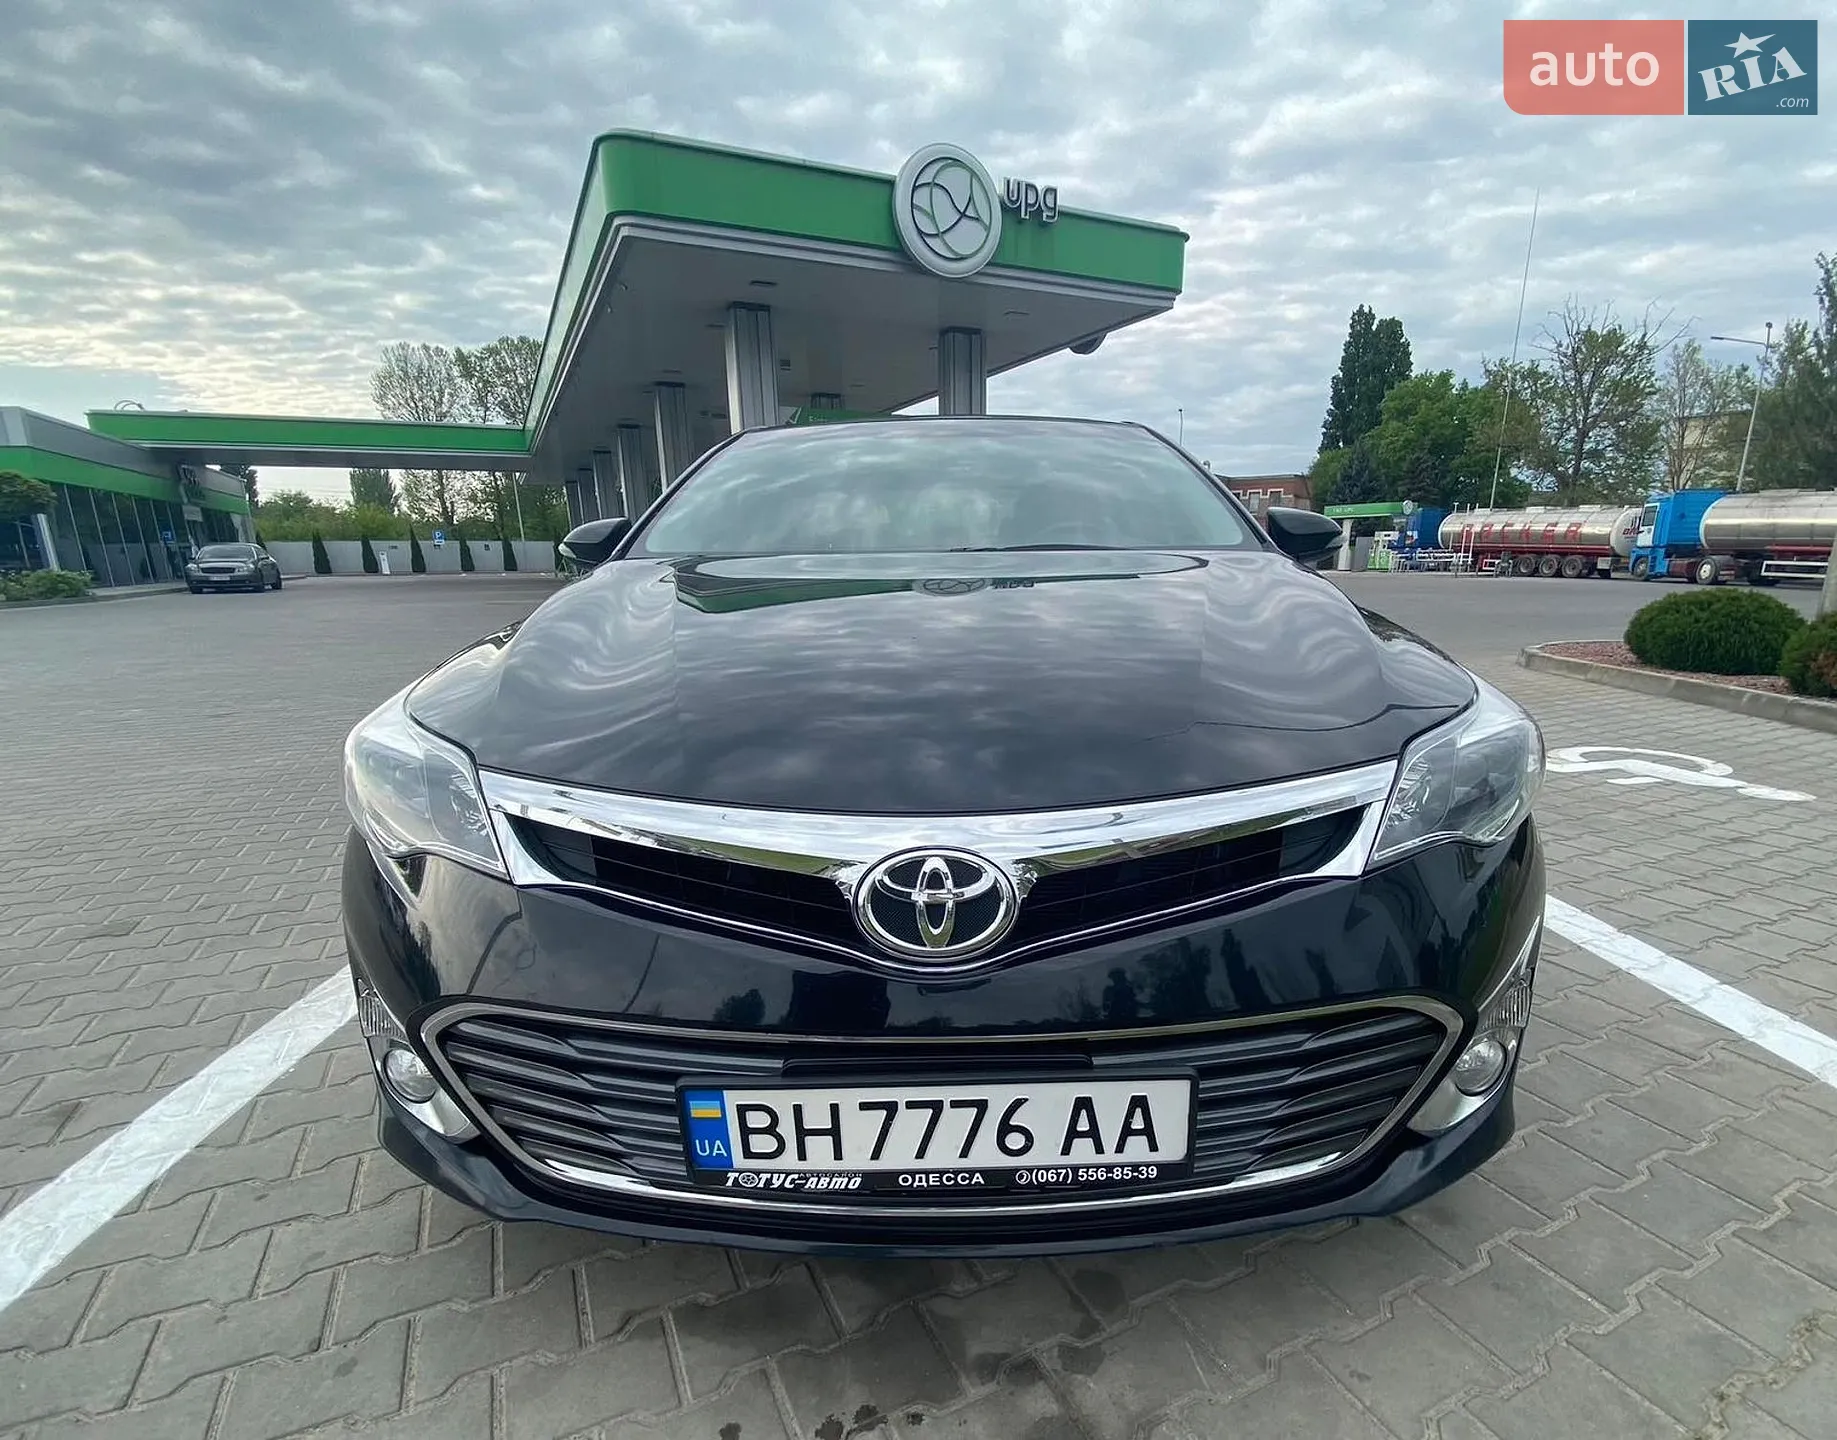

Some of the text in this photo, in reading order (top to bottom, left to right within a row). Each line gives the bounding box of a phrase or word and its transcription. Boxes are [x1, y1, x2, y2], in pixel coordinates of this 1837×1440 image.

[1003, 176, 1059, 222] upg
[735, 1094, 1160, 1162] BH 7776 AA
[695, 1139, 728, 1157] UA
[898, 1173, 985, 1188] ОДЕССА
[1031, 1165, 1158, 1185] (067) 556-85-39
